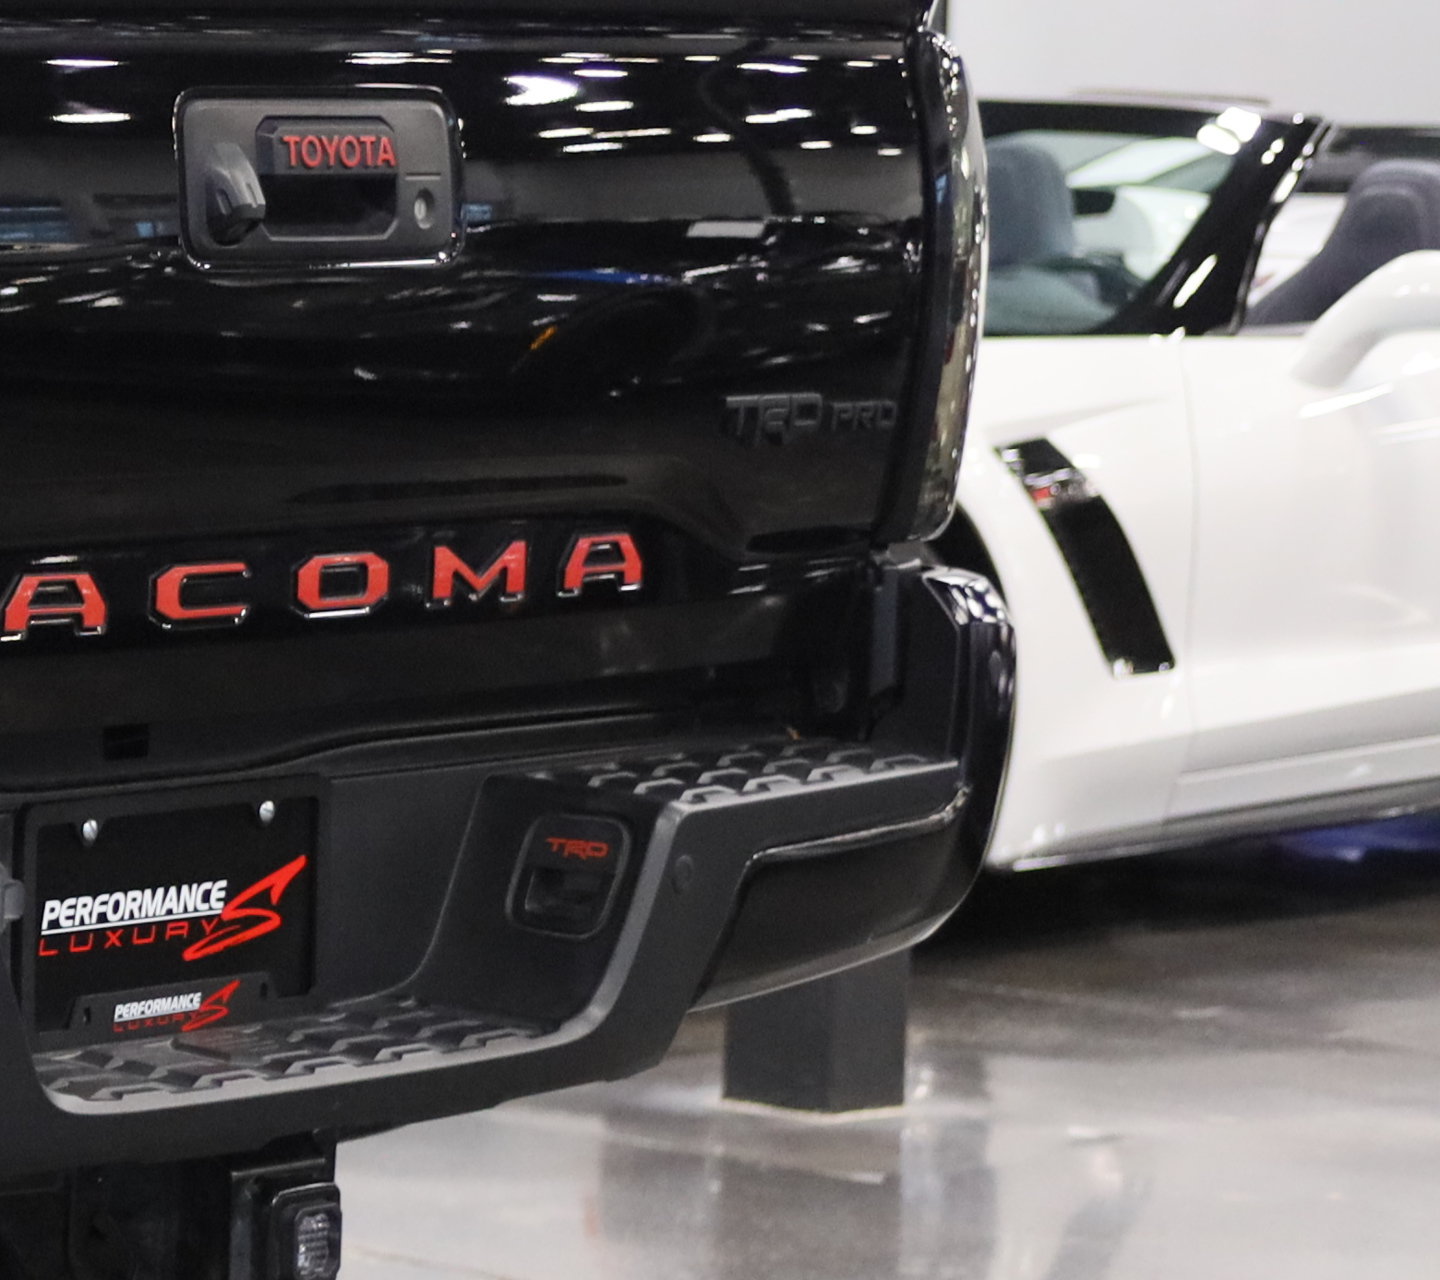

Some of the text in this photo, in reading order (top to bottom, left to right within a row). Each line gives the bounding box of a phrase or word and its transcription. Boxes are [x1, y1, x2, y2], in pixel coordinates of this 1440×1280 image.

[281, 134, 397, 168] TOYOTA
[726, 392, 896, 447] TRD PRO
[545, 836, 610, 861] TRD
[40, 878, 228, 932] PERFORMANCE
[38, 916, 221, 957] LUXURY
[113, 991, 202, 1021] PERFORMANCE
